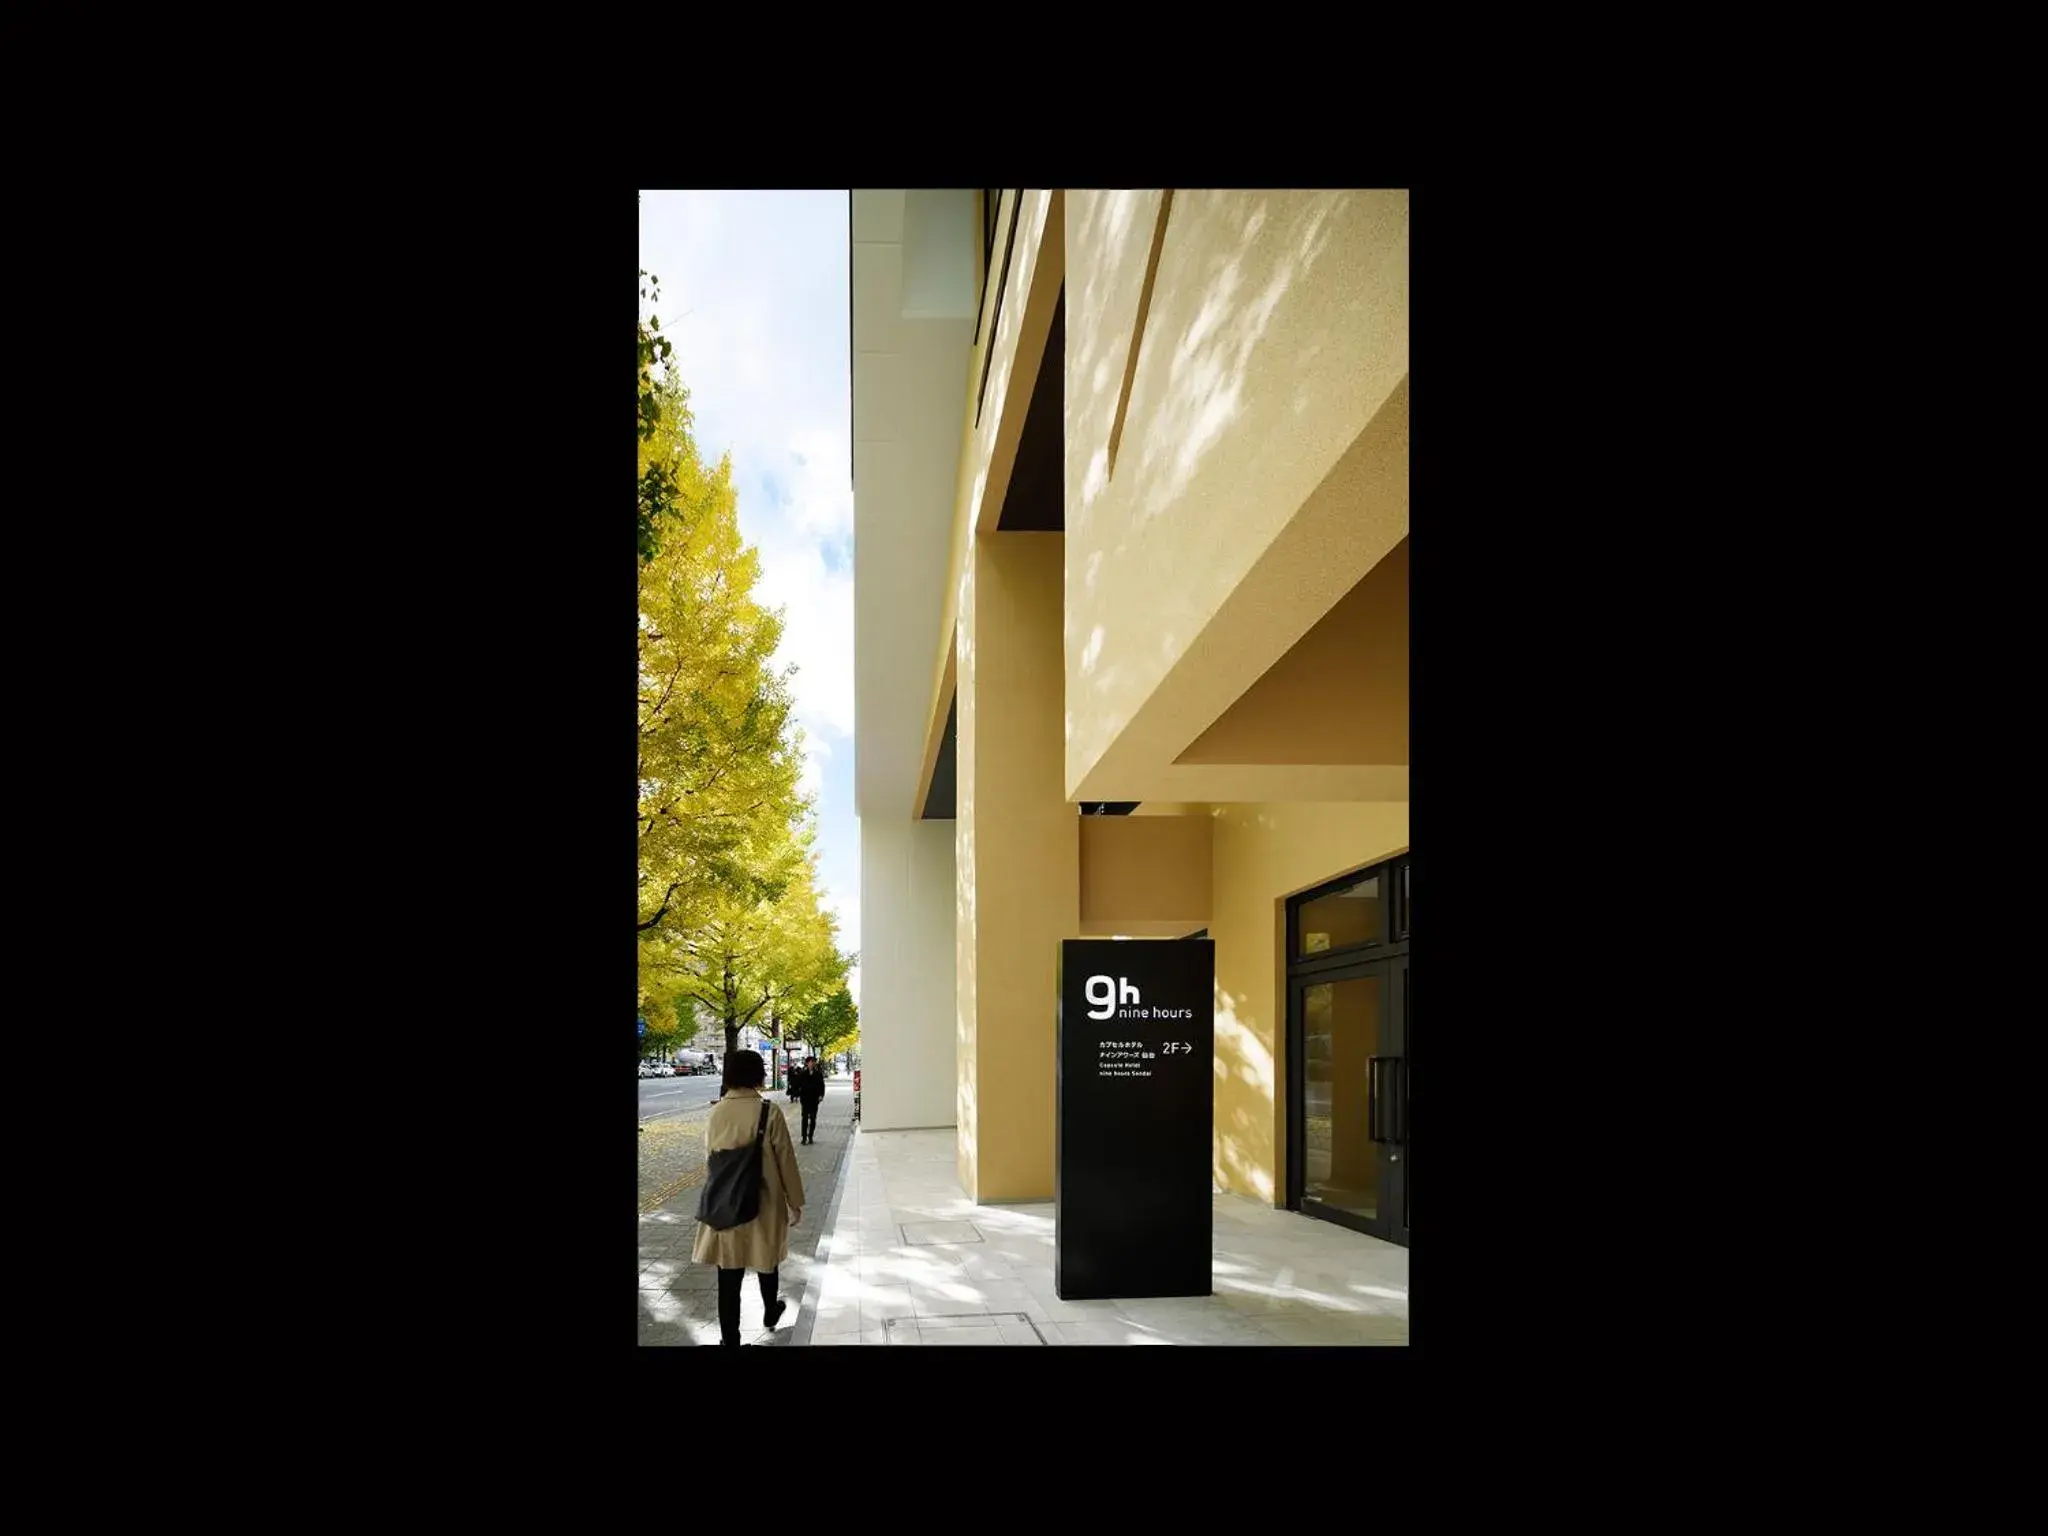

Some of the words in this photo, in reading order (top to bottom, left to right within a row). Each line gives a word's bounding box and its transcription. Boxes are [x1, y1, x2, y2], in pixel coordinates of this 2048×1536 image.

[1085, 975, 1140, 1020] 9h
[1119, 1006, 1148, 1018] nine
[1153, 1006, 1192, 1018] hours
[1162, 1042, 1180, 1054] 2F
